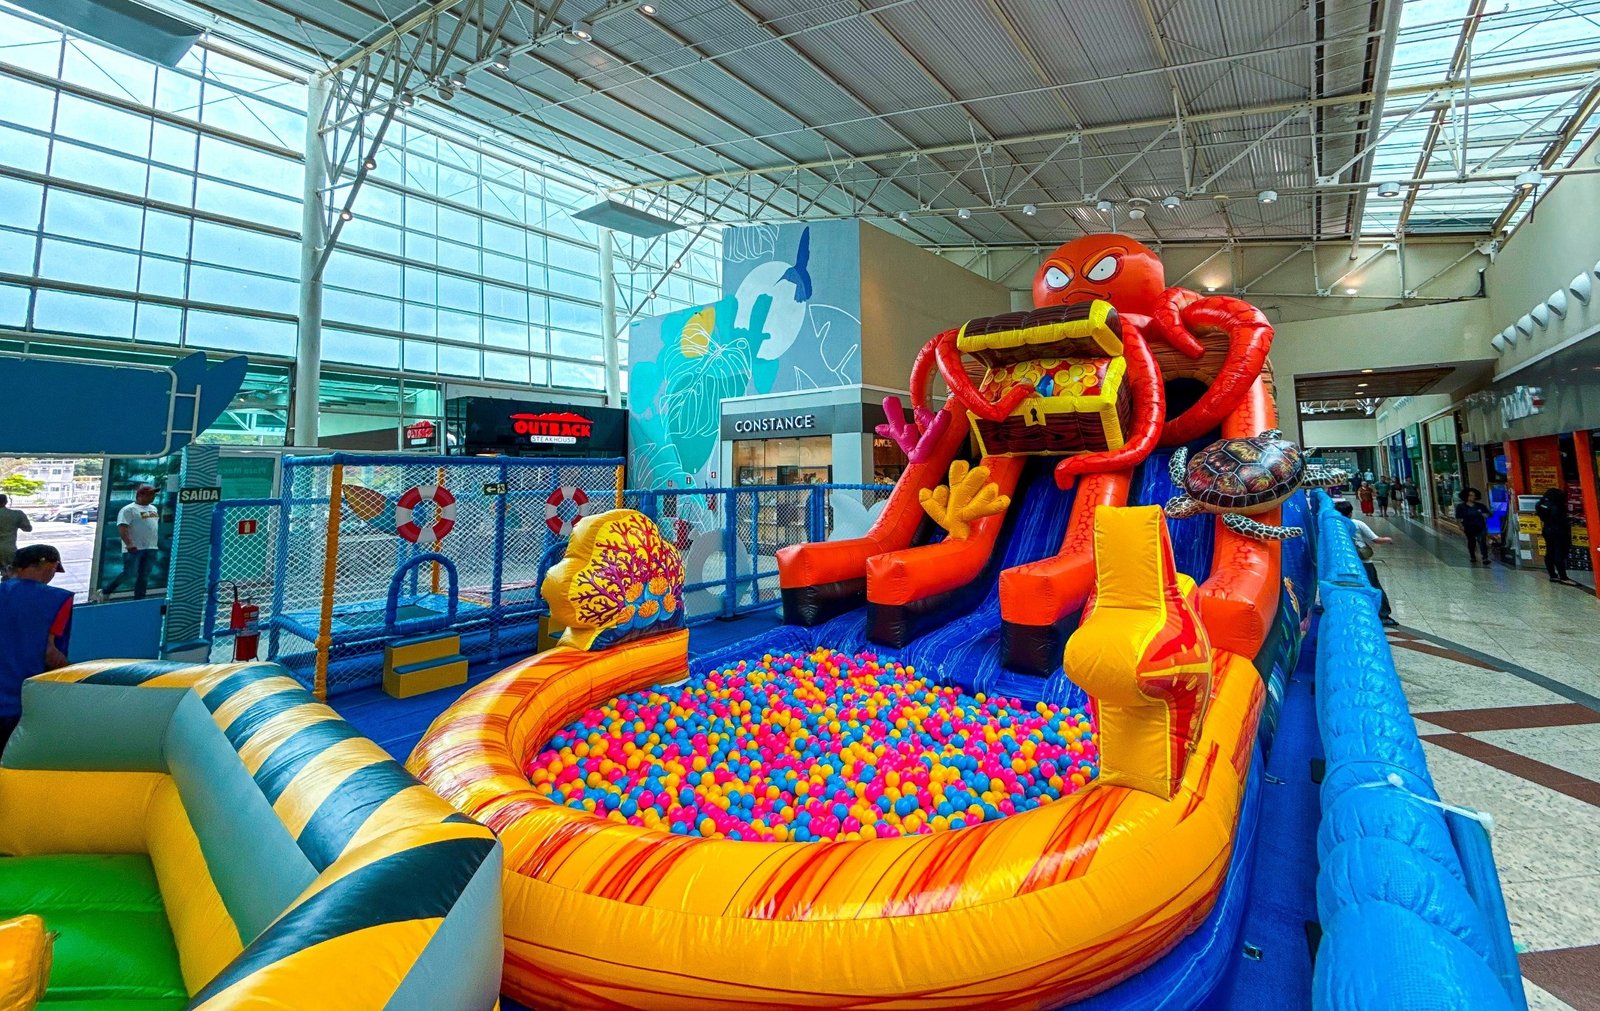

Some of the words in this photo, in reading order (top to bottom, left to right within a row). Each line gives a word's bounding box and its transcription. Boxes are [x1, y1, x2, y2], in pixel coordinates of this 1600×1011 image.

[513, 420, 591, 437] OUTBACK
[734, 414, 813, 432] CONSTANCE
[181, 488, 219, 501] SAÍDA
